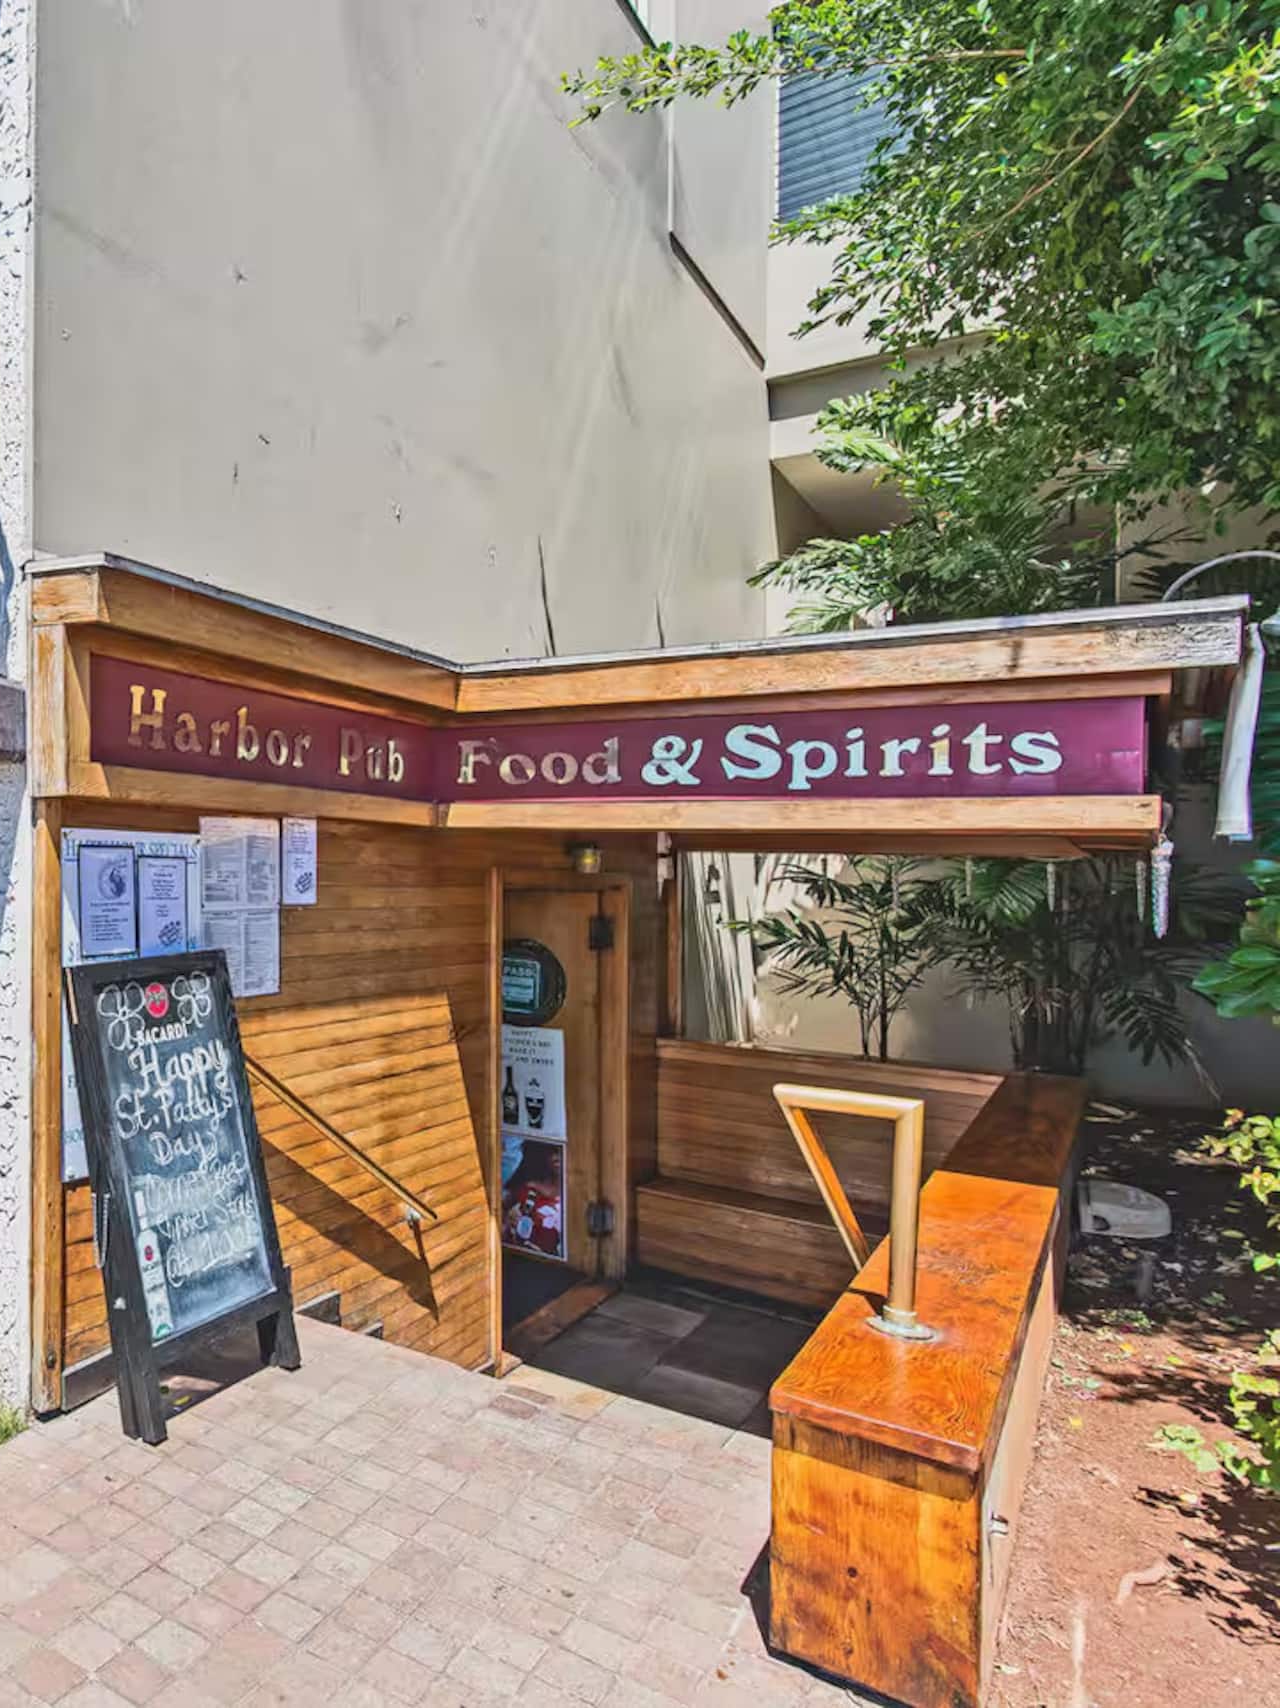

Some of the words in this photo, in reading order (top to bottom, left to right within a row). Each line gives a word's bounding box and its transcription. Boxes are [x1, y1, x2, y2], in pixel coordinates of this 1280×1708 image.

[127, 684, 312, 769] Harbor
[337, 727, 405, 783] Pub
[456, 736, 621, 786] Food
[641, 734, 703, 786] &
[720, 723, 1063, 791] Spirits
[128, 1039, 231, 1098] Happy
